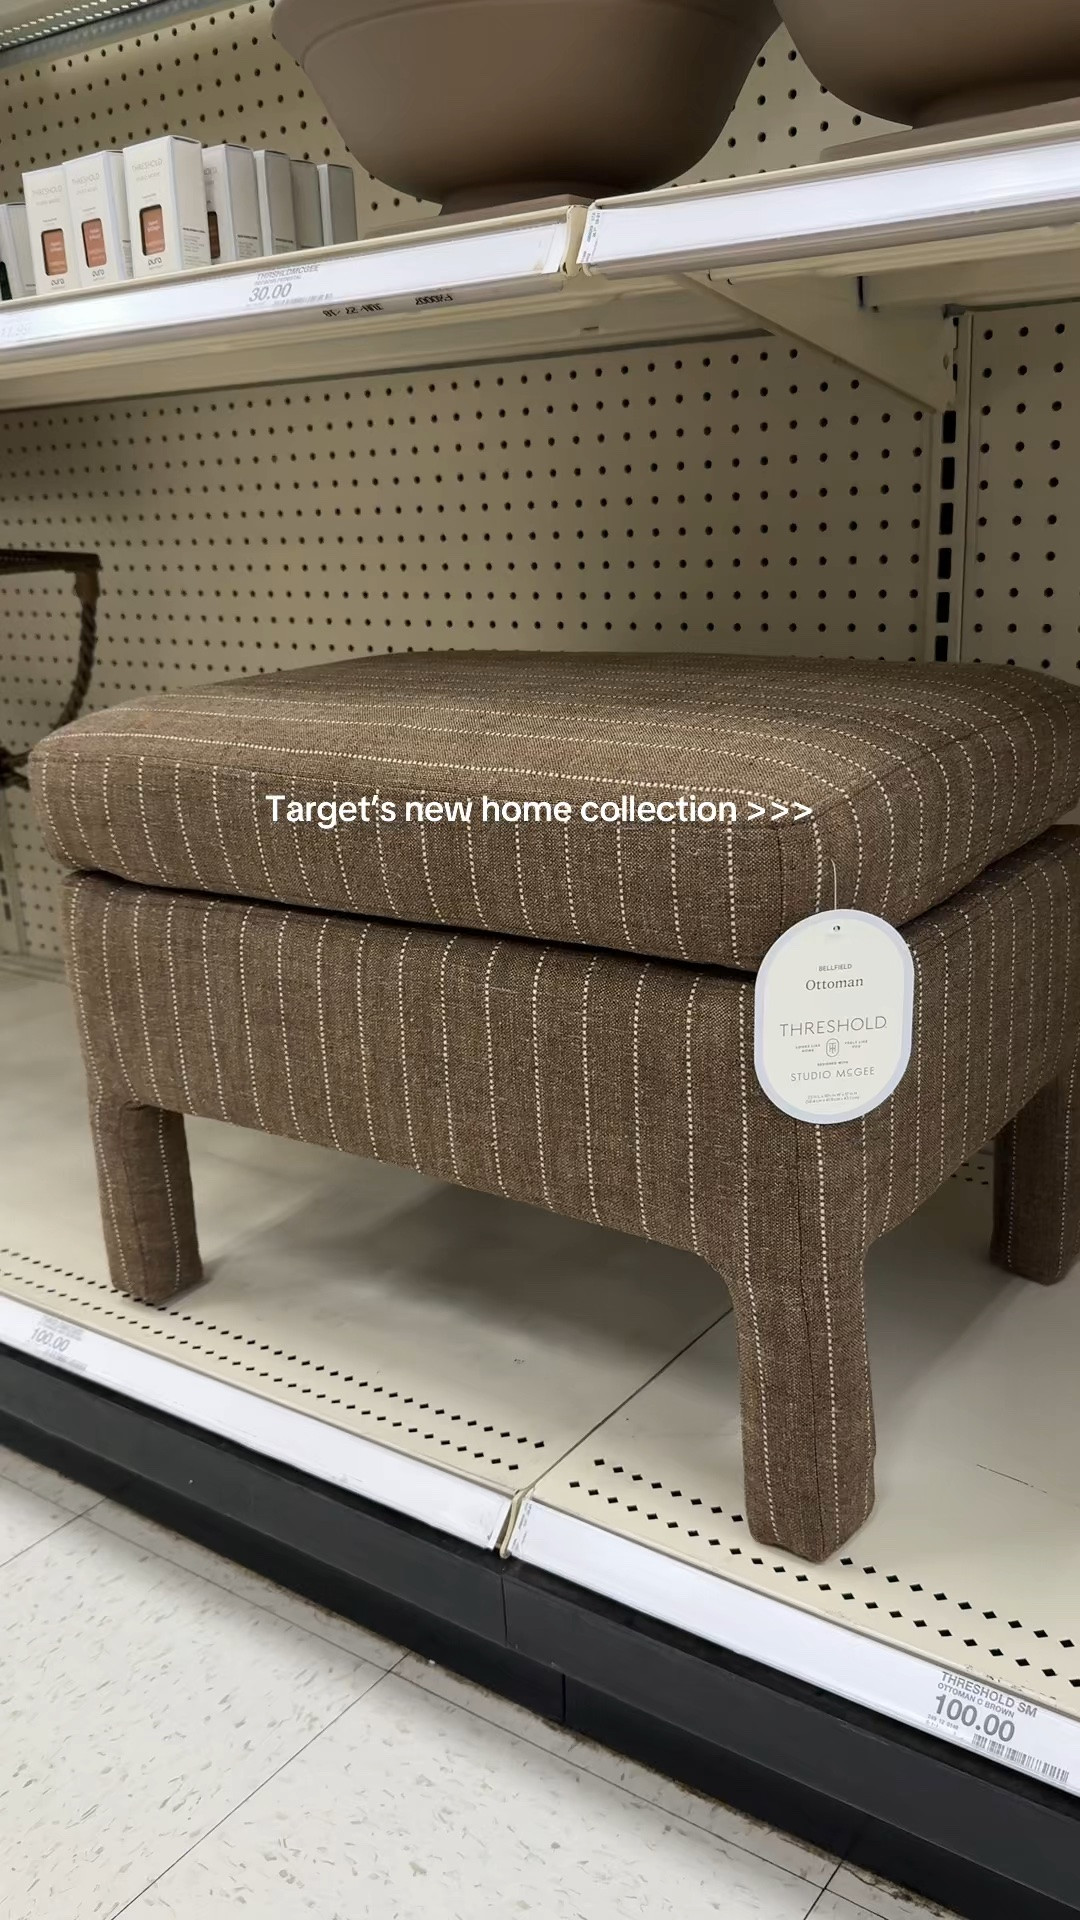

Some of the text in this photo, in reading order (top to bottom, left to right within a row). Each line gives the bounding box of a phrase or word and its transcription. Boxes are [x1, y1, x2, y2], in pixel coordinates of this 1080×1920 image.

[249, 282, 292, 302] 30.00
[818, 963, 853, 972] BELLFIELD
[805, 978, 864, 991] Ottoman
[779, 1015, 887, 1037] THRESHOLD
[790, 1070, 832, 1082] STUDIO
[31, 1328, 70, 1352] 100.00
[937, 1682, 1015, 1718] OTTOMAN C BROWN
[941, 1671, 1038, 1718] THRESHOLD SM
[935, 1694, 1016, 1742] 100.00
